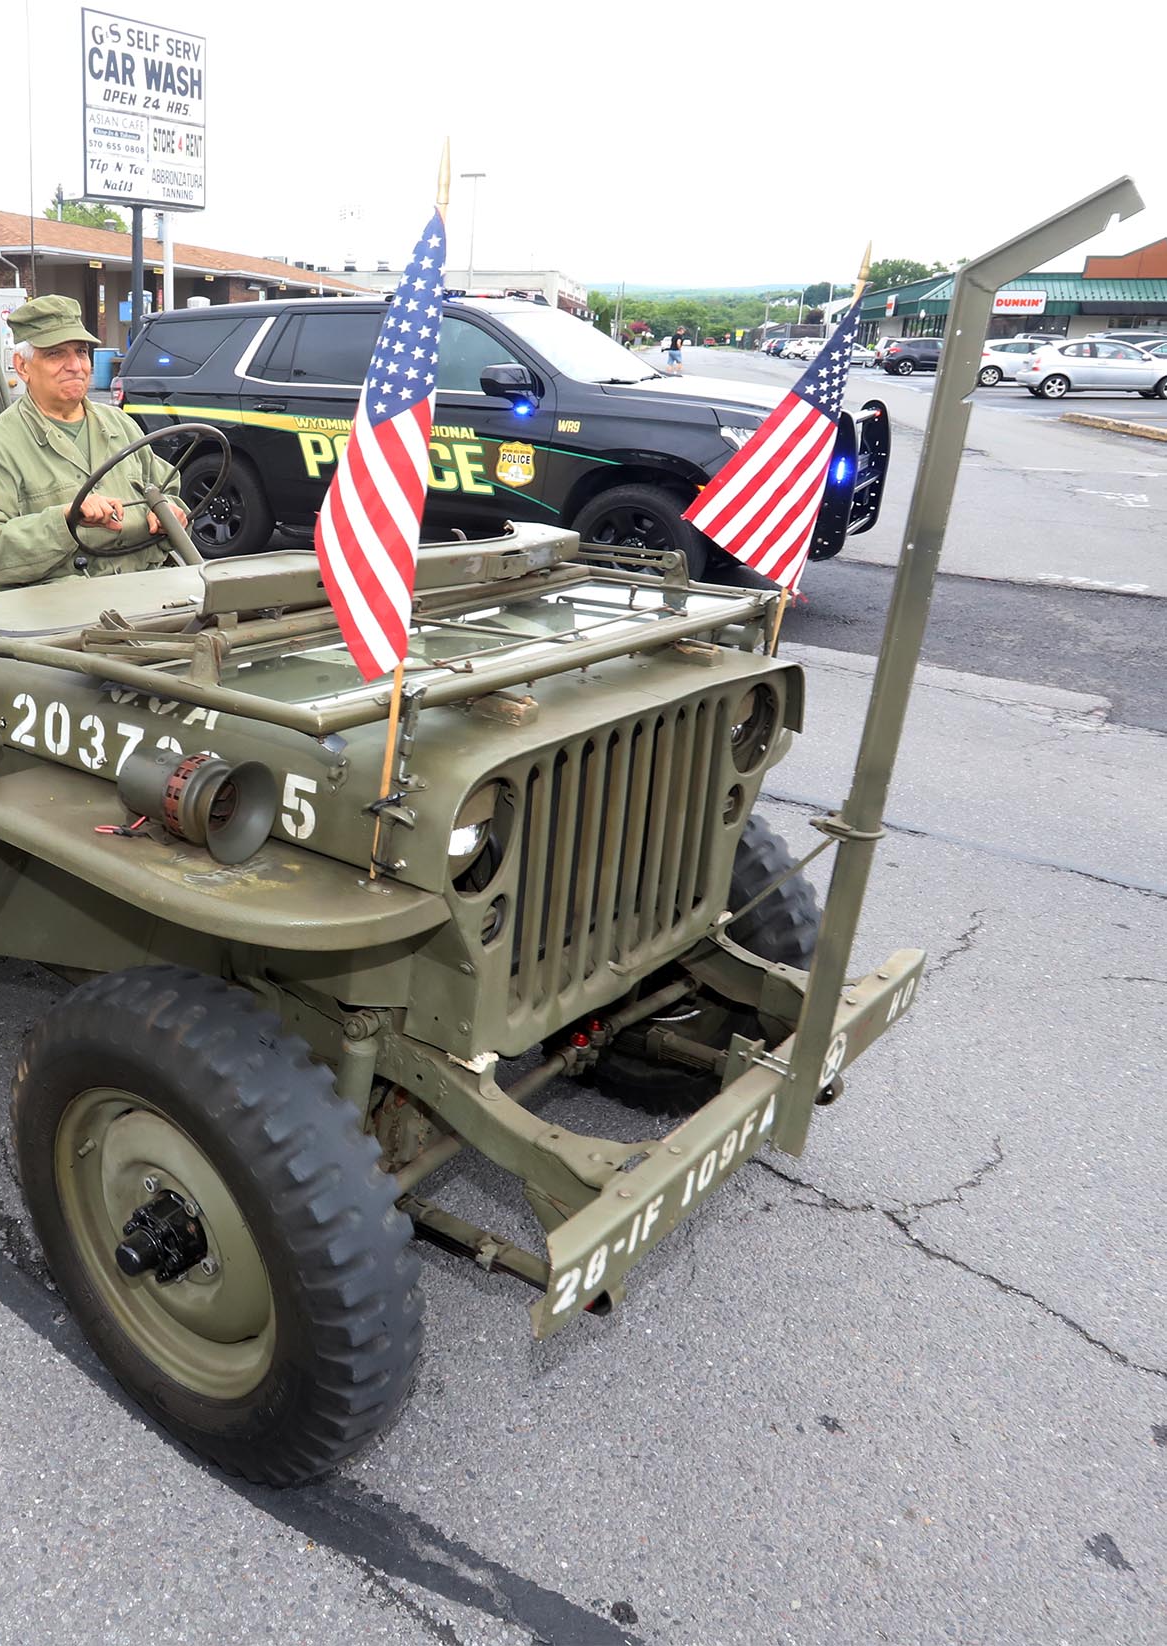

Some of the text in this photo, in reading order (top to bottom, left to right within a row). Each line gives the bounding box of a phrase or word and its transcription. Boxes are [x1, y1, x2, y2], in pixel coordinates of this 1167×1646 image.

[127, 28, 160, 53] SELF
[166, 37, 201, 62] SERV
[88, 46, 202, 100] CAR WASH
[103, 88, 137, 106] OPEN
[142, 96, 160, 110] 24
[89, 113, 144, 132] ASIAN CAFE
[88, 139, 103, 148] 570
[153, 127, 175, 154] STORE
[178, 135, 183, 152] 4
[186, 133, 203, 158] RENT
[89, 158, 109, 174] Tip
[114, 161, 123, 172] N
[103, 178, 133, 192] Nails
[151, 168, 203, 190] ABBRONZATURA
[162, 186, 194, 201] TANNING
[995, 298, 1043, 307] DUNKIN'
[294, 416, 355, 431] WYOMIN
[557, 419, 581, 433] WR9
[501, 453, 531, 465] POLICE
